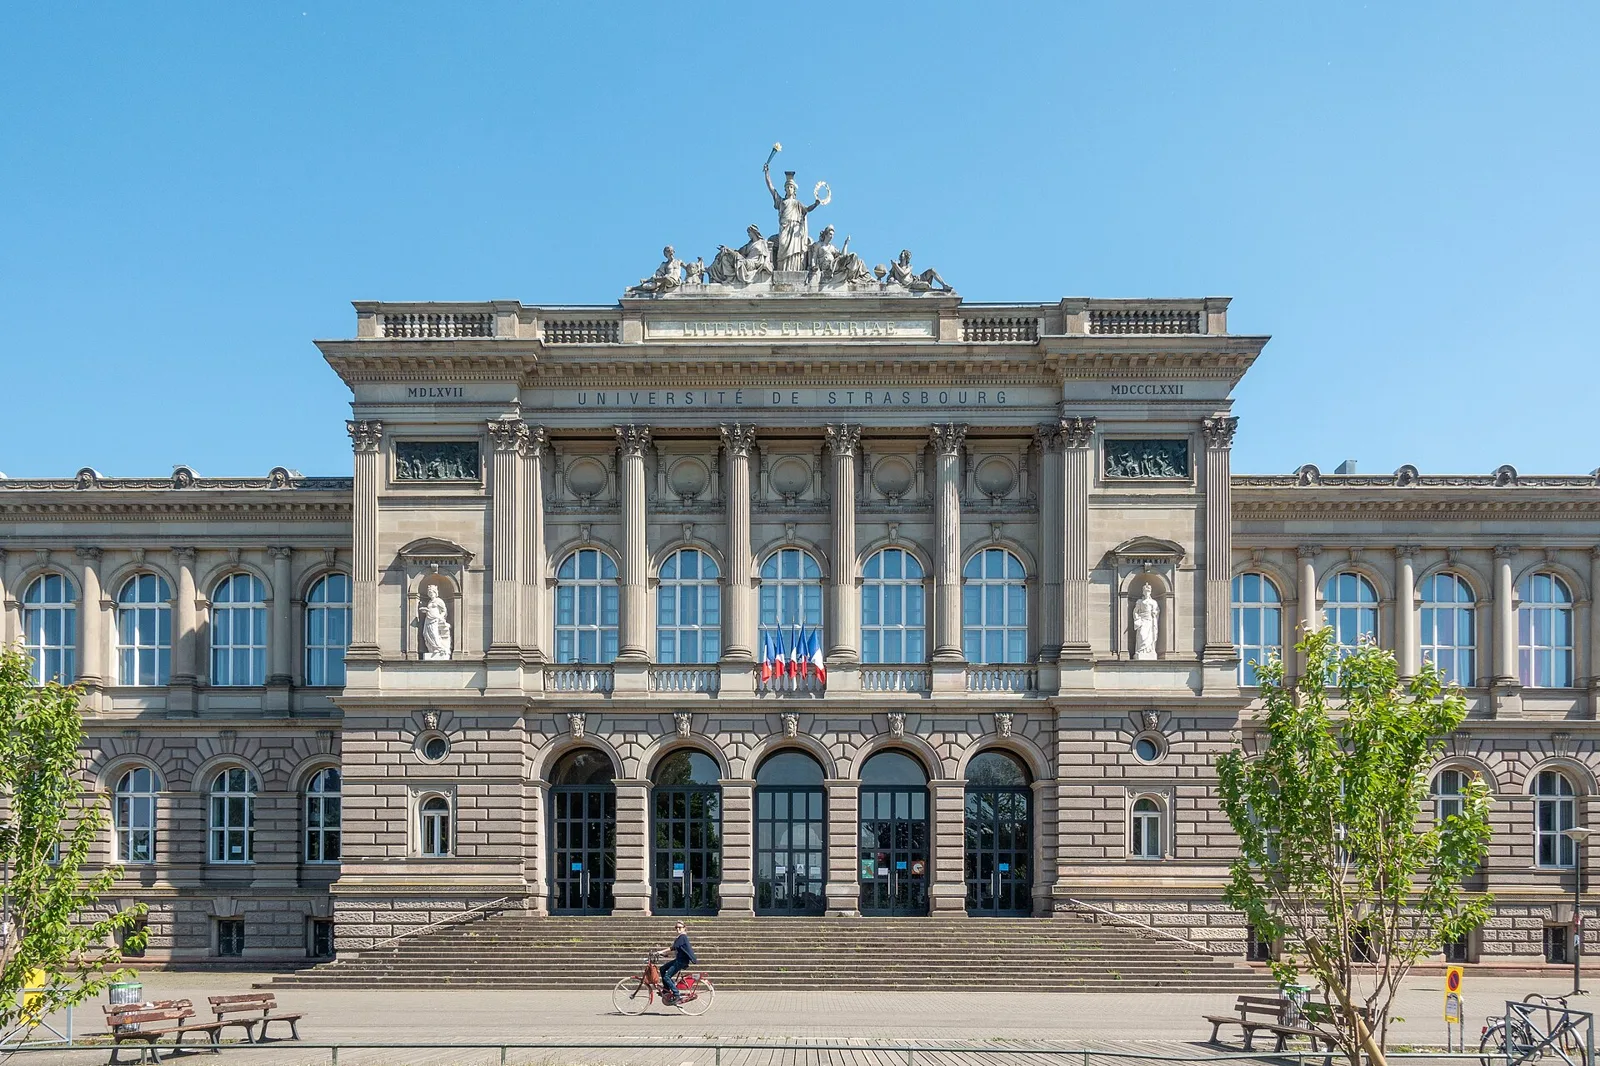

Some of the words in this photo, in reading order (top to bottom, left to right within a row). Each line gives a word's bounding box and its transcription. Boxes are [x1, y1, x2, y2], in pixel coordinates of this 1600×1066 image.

[683, 322, 768, 336] LITTERIS
[781, 322, 803, 336] ET
[408, 387, 463, 397] MDLXVII
[1111, 385, 1184, 395] MDCCCLXXII
[578, 389, 743, 405] UNIVERSITÉ
[772, 391, 799, 405] DE
[828, 391, 1006, 405] STRASBOURG
